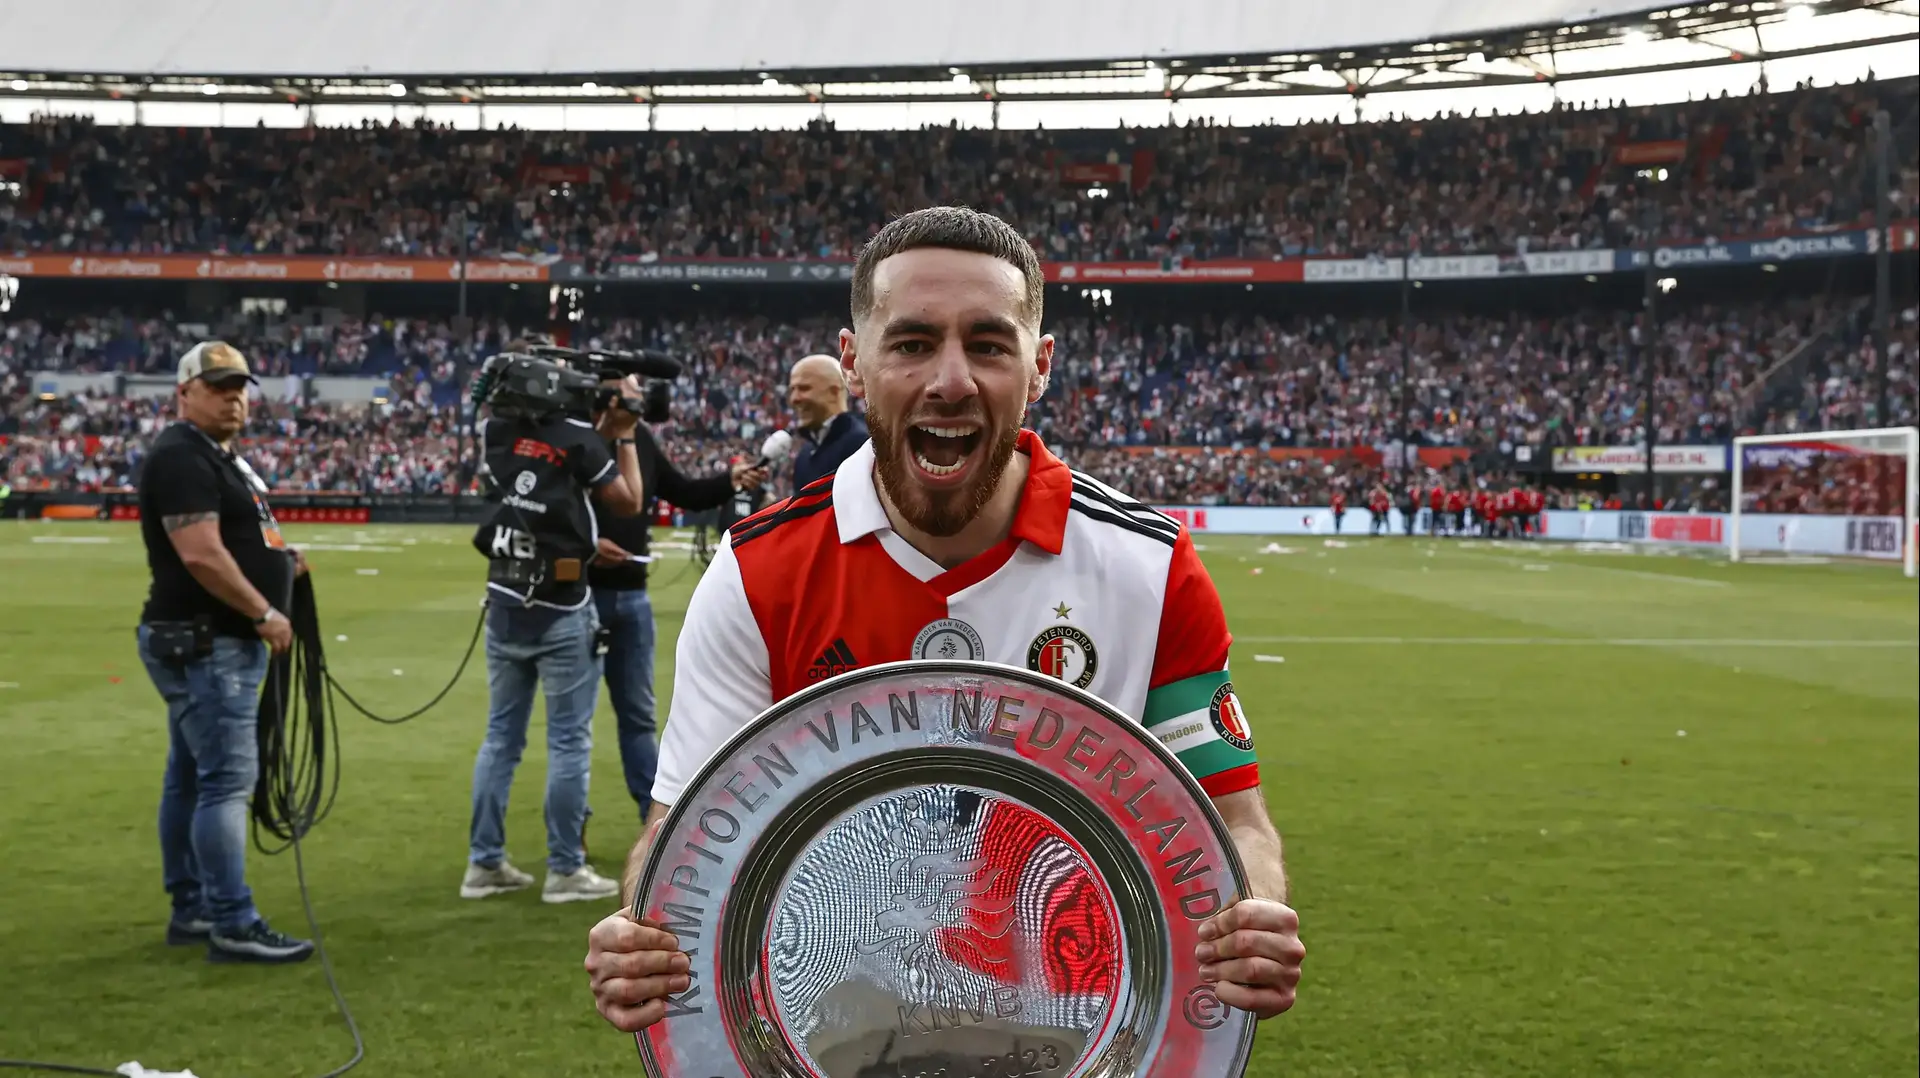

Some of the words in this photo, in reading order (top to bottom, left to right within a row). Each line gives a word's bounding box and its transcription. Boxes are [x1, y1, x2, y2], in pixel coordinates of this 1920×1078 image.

[914, 624, 937, 656] KAMPIOEN
[954, 622, 982, 657] NEDERLAND
[1032, 627, 1093, 652] FEYENOORD
[808, 664, 858, 679] adid
[1211, 683, 1235, 712] FEYEN
[1160, 722, 1204, 743] ENOORD
[804, 690, 921, 754] VAN
[952, 688, 1223, 922] NEDERLAND
[897, 985, 1023, 1038] KNVB
